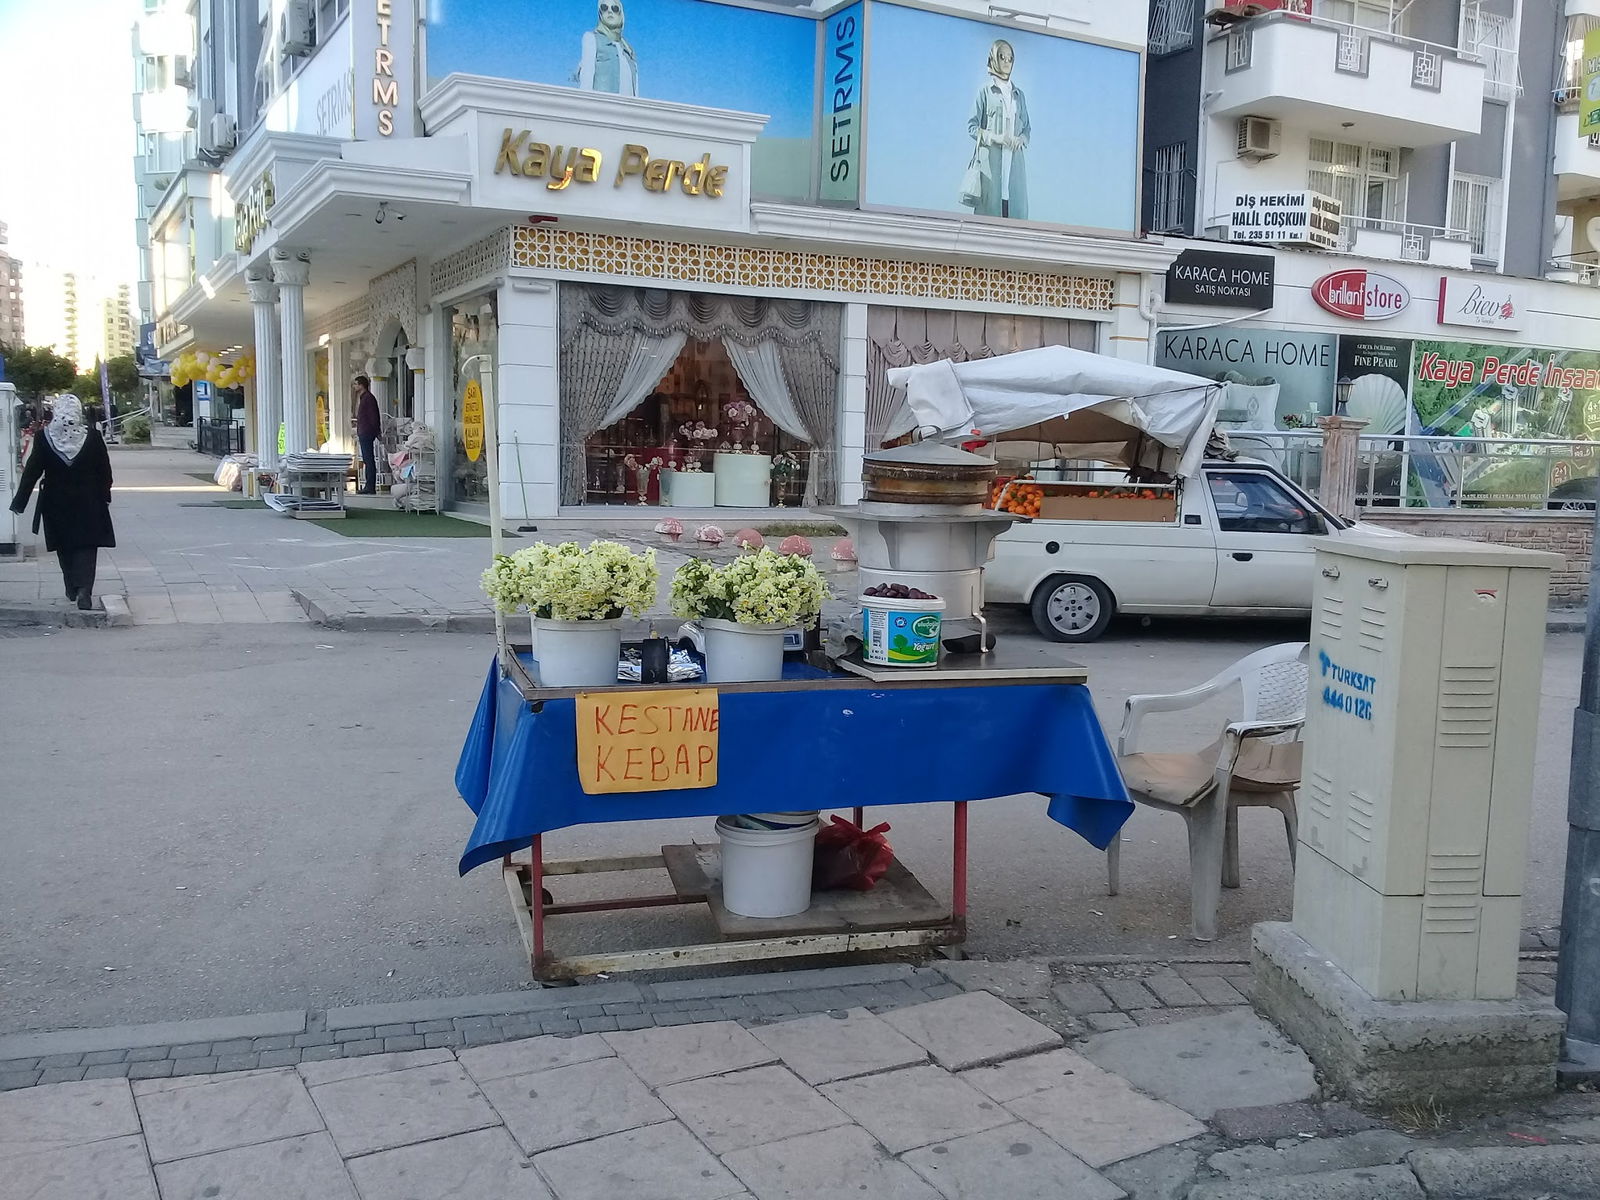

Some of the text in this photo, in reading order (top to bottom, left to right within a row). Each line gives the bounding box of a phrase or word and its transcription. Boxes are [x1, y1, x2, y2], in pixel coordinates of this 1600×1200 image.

[831, 15, 855, 182] SETRMS
[494, 128, 729, 197] Kaya Perde
[1236, 194, 1305, 209] DİŞ HEKİMİ
[1232, 210, 1307, 228] HALİL COŞKUN
[1233, 230, 1247, 239] Tel.
[1248, 231, 1263, 239] 235
[1265, 231, 1274, 239] 51
[1277, 231, 1286, 239] 11
[1175, 265, 1270, 286] KARACA HOME
[1195, 284, 1251, 297] SATIŞ NOKTASI
[1366, 284, 1402, 309] store
[1164, 335, 1330, 367] KARACA HOME
[1354, 355, 1398, 368] FINE PEARL
[1418, 351, 1475, 389] Kaya
[1480, 356, 1540, 387] Perde
[1331, 663, 1376, 694] TURKSAT
[595, 704, 720, 736] KESTANE
[596, 744, 714, 782] KEBAP
